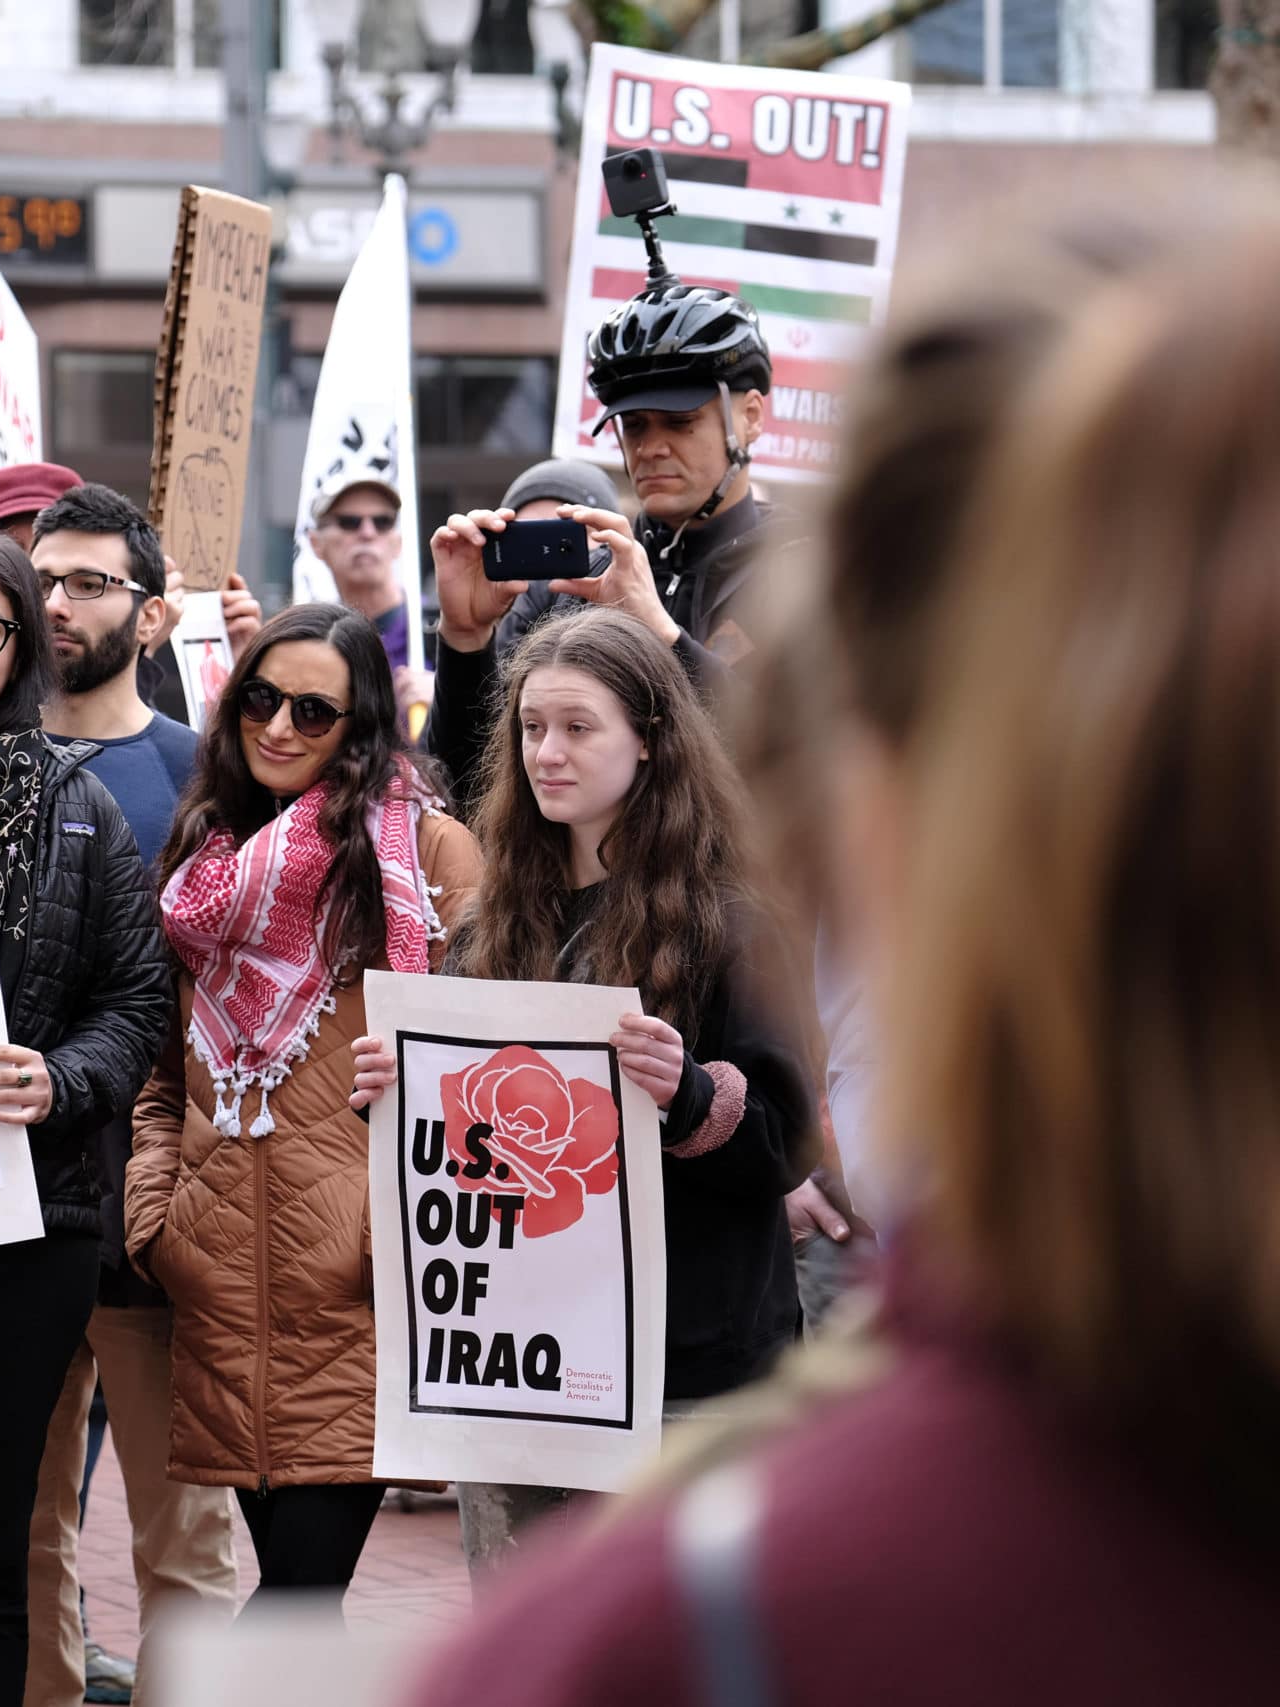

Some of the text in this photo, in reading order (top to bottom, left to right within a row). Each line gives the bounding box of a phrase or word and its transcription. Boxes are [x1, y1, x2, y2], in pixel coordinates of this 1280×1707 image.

[613, 77, 884, 169] U.S. OUT!
[197, 326, 237, 378] WAR
[412, 1118, 509, 1180] U.S.
[416, 1189, 524, 1249] OUT
[422, 1258, 489, 1316] OF
[425, 1327, 561, 1391] IRAQ
[566, 1368, 613, 1380] Democratic
[566, 1380, 613, 1392] Socialists of
[566, 1391, 600, 1401] America
